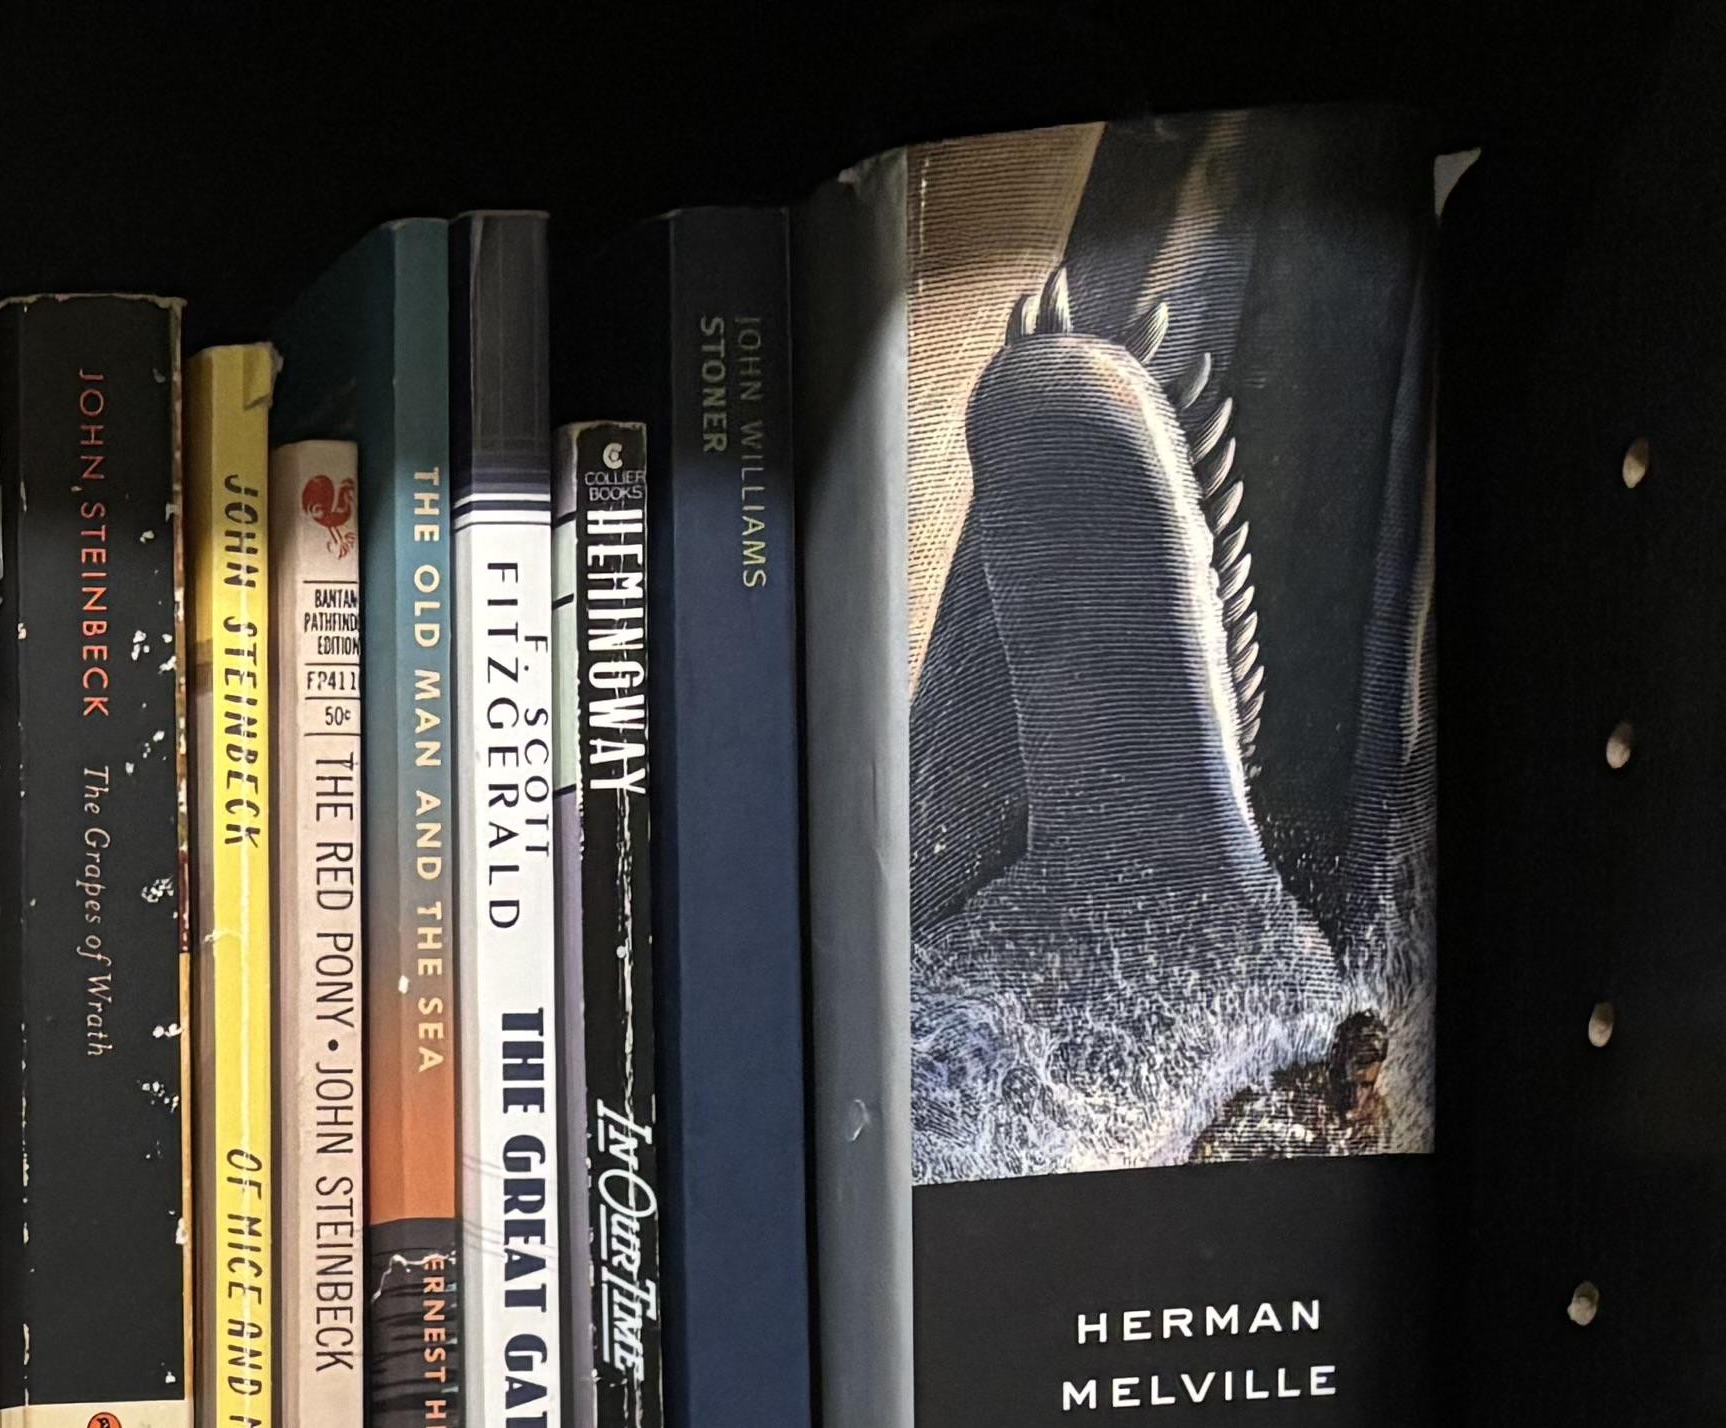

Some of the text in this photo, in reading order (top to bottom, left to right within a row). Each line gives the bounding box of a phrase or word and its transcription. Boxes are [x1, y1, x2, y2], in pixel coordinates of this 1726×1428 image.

[584, 508, 647, 796] HEMINGWAY
[501, 1006, 546, 1115] THE
[502, 1133, 548, 1314] GREAT
[1077, 1299, 1320, 1345] HERMAN
[1062, 1364, 1337, 1412] MELVILLE
